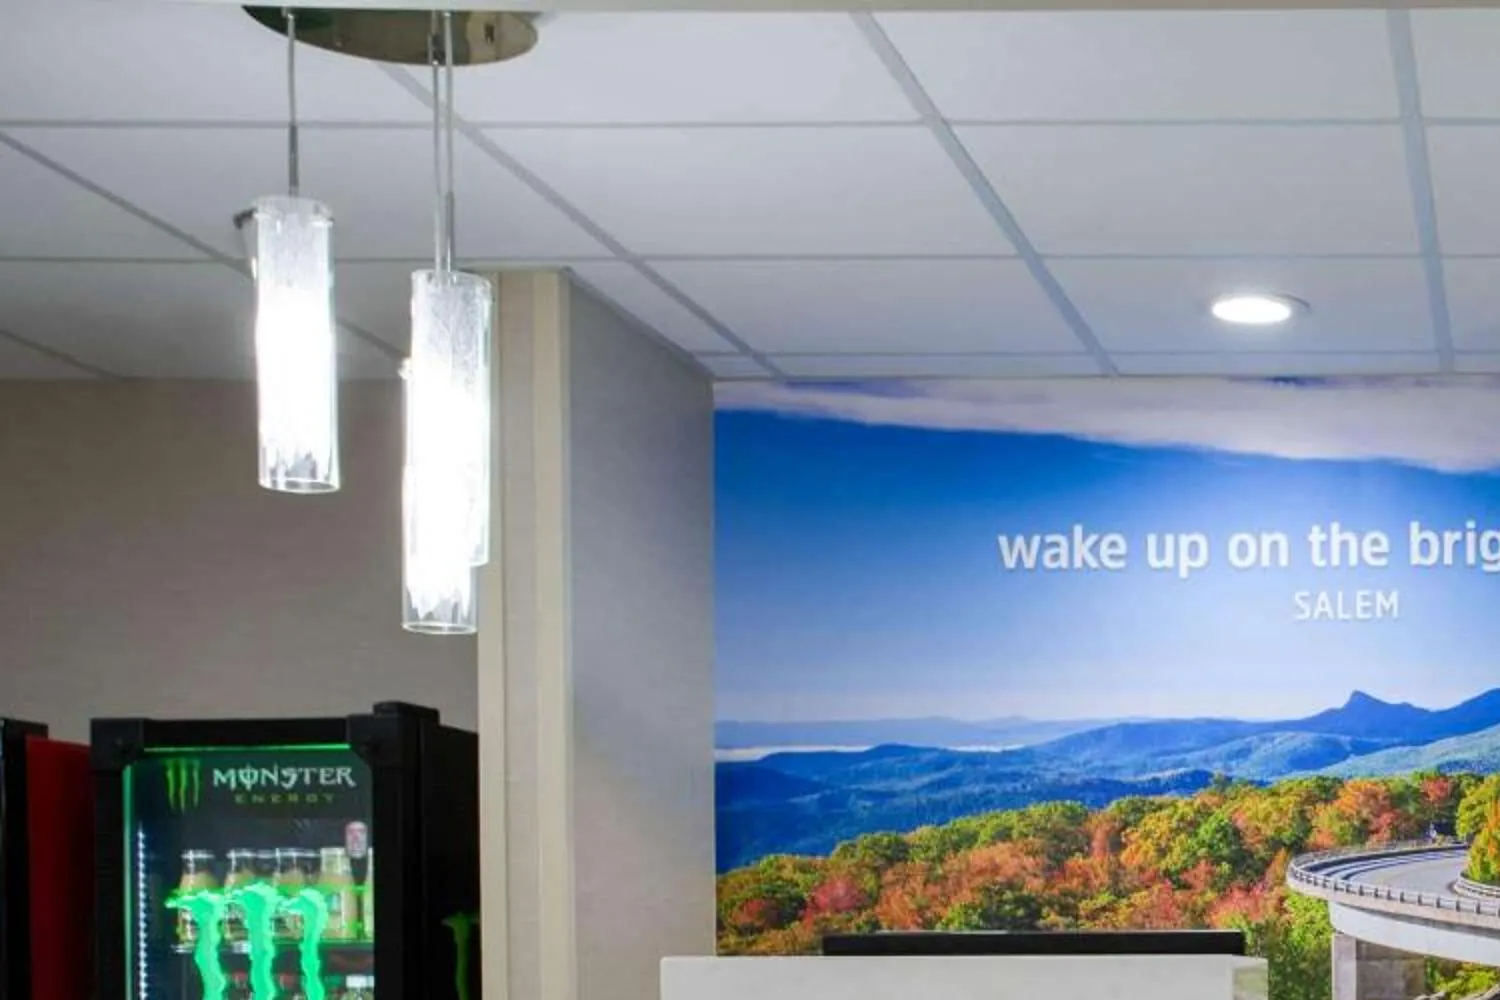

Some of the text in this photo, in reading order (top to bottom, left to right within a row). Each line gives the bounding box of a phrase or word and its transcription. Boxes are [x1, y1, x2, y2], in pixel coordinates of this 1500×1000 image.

[998, 525, 1127, 569] wake
[1147, 532, 1209, 579] up
[1227, 531, 1288, 567] on
[1308, 522, 1390, 567] the
[1294, 591, 1398, 620] SALEM
[213, 763, 357, 791] MONSTER
